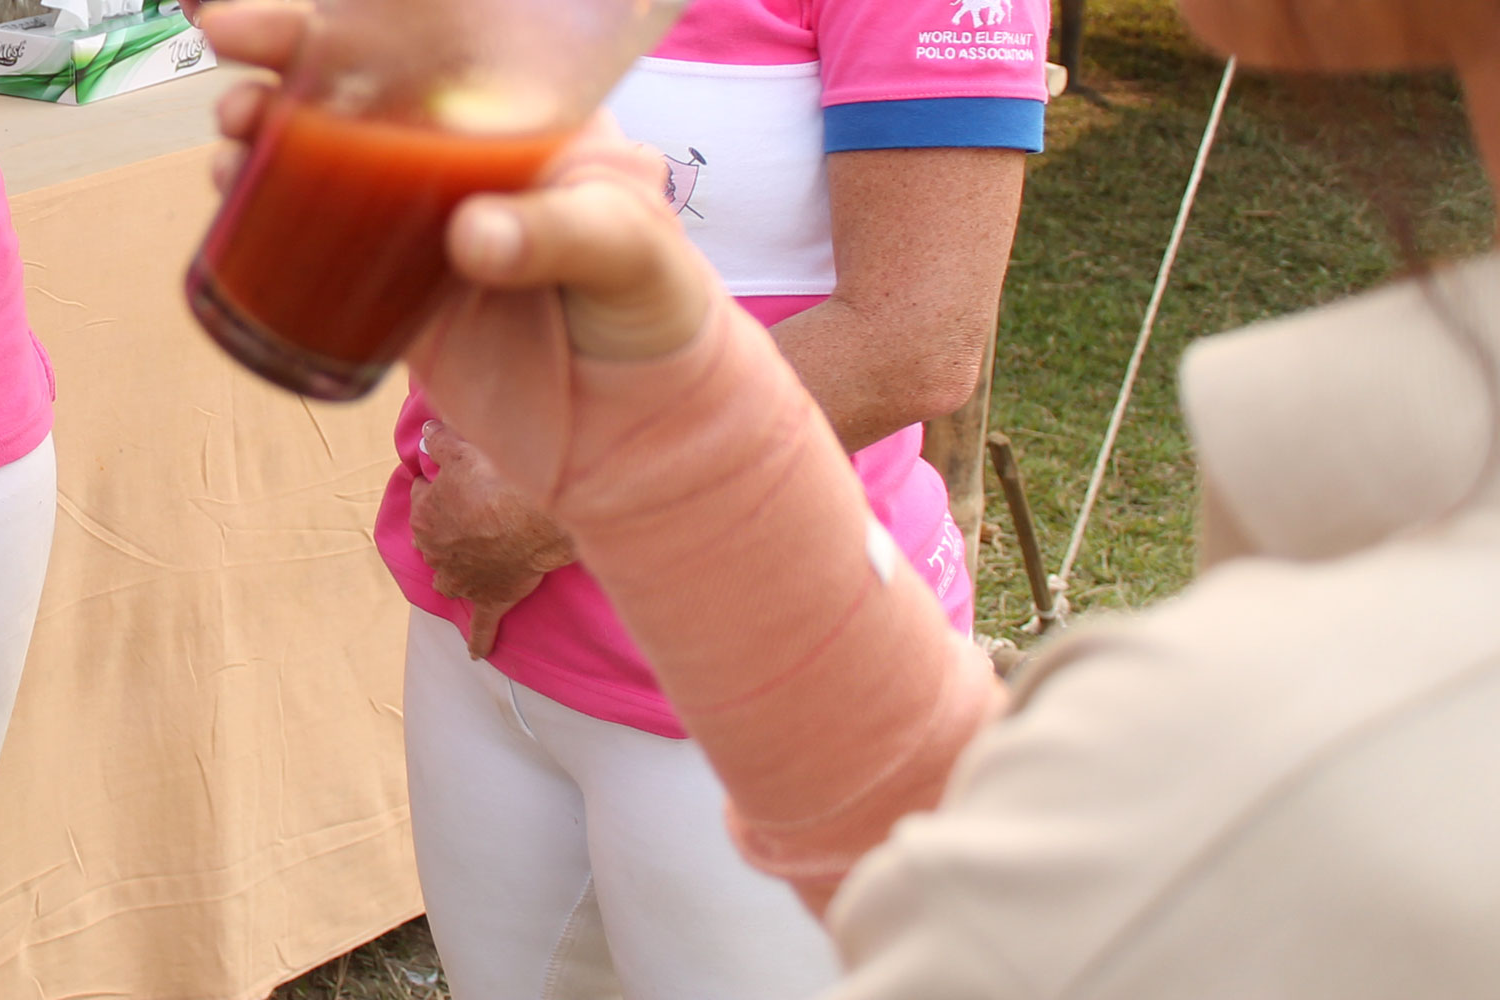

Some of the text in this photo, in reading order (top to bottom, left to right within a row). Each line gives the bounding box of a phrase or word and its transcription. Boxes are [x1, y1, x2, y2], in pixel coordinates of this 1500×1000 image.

[919, 31, 1034, 46] WORLD ELEPHANT
[916, 47, 956, 60] POLO
